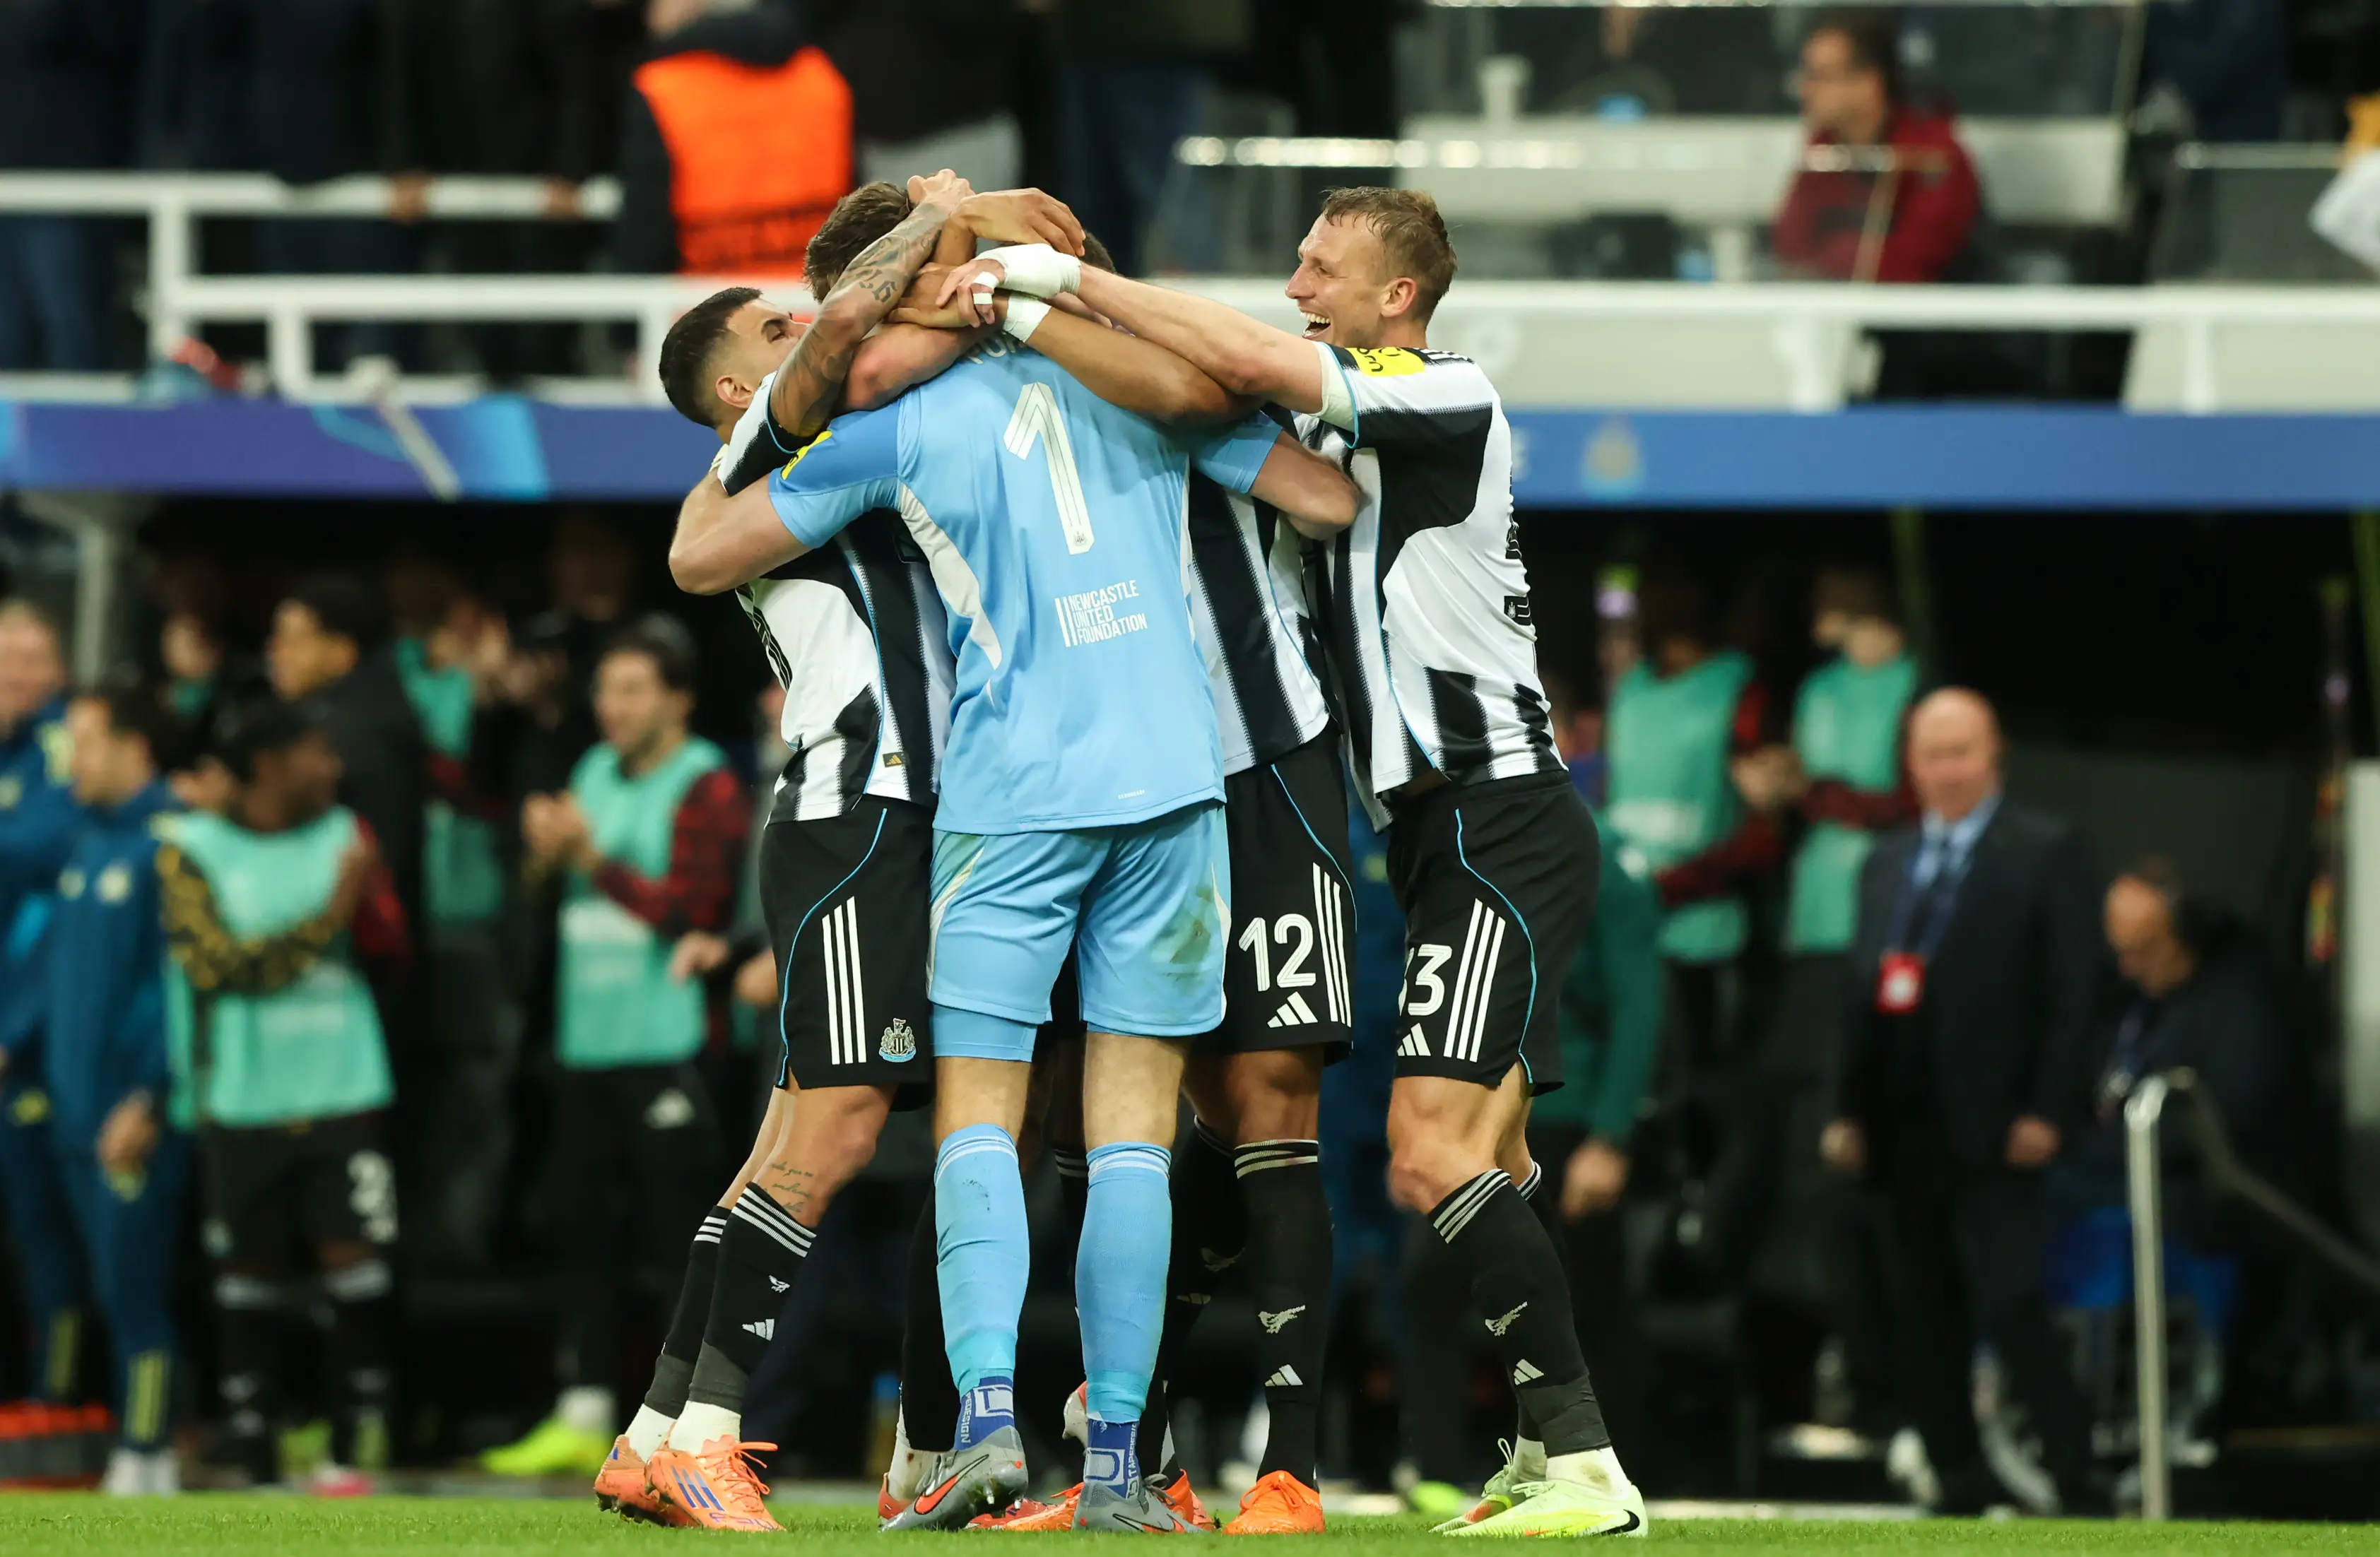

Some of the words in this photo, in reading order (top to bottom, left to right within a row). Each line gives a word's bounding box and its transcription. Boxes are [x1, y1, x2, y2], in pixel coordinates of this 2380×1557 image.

[1003, 381, 1095, 555] 1
[1068, 579, 1140, 612] NEWCASTLE
[1073, 605, 1114, 629] UNITED
[1077, 612, 1148, 644] FOUNDATION
[1238, 913, 1316, 992] 12
